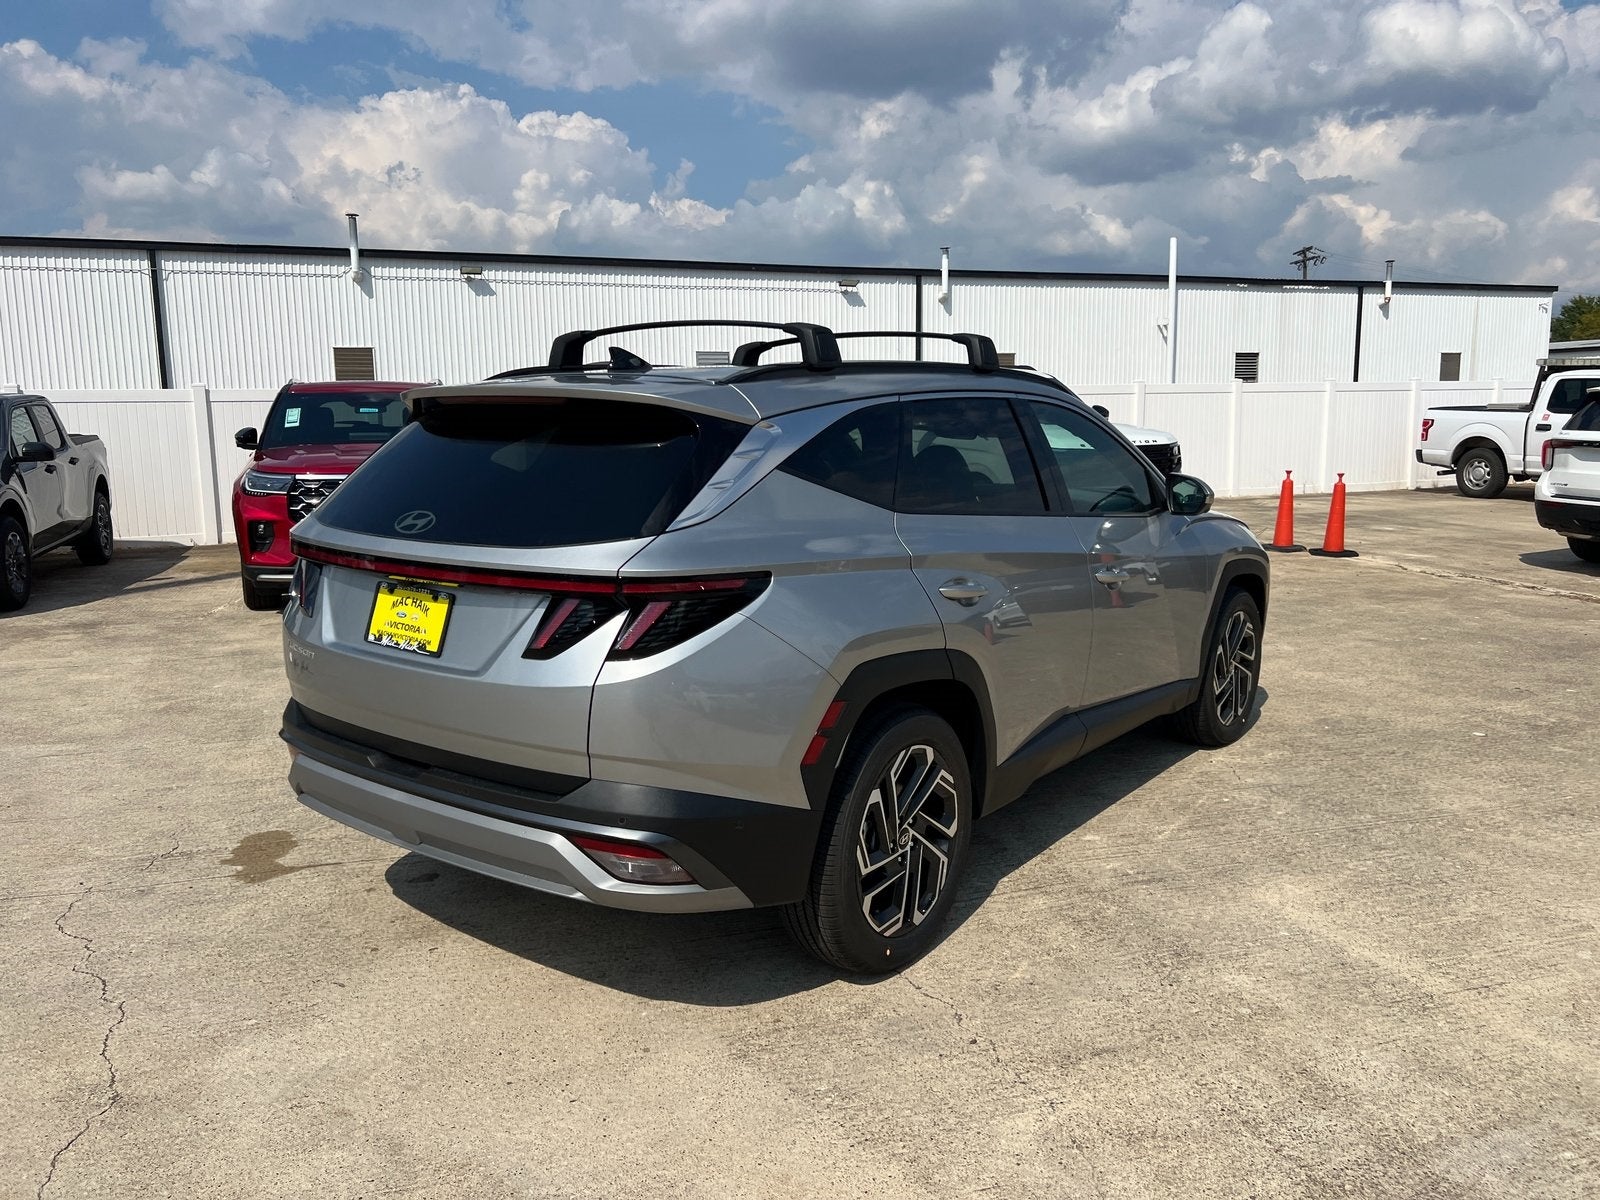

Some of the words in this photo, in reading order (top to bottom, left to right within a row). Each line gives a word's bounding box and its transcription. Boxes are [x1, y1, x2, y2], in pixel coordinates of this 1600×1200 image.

[390, 596, 410, 610] MAC
[411, 597, 430, 617] HAIK
[390, 620, 421, 634] VICTORIA
